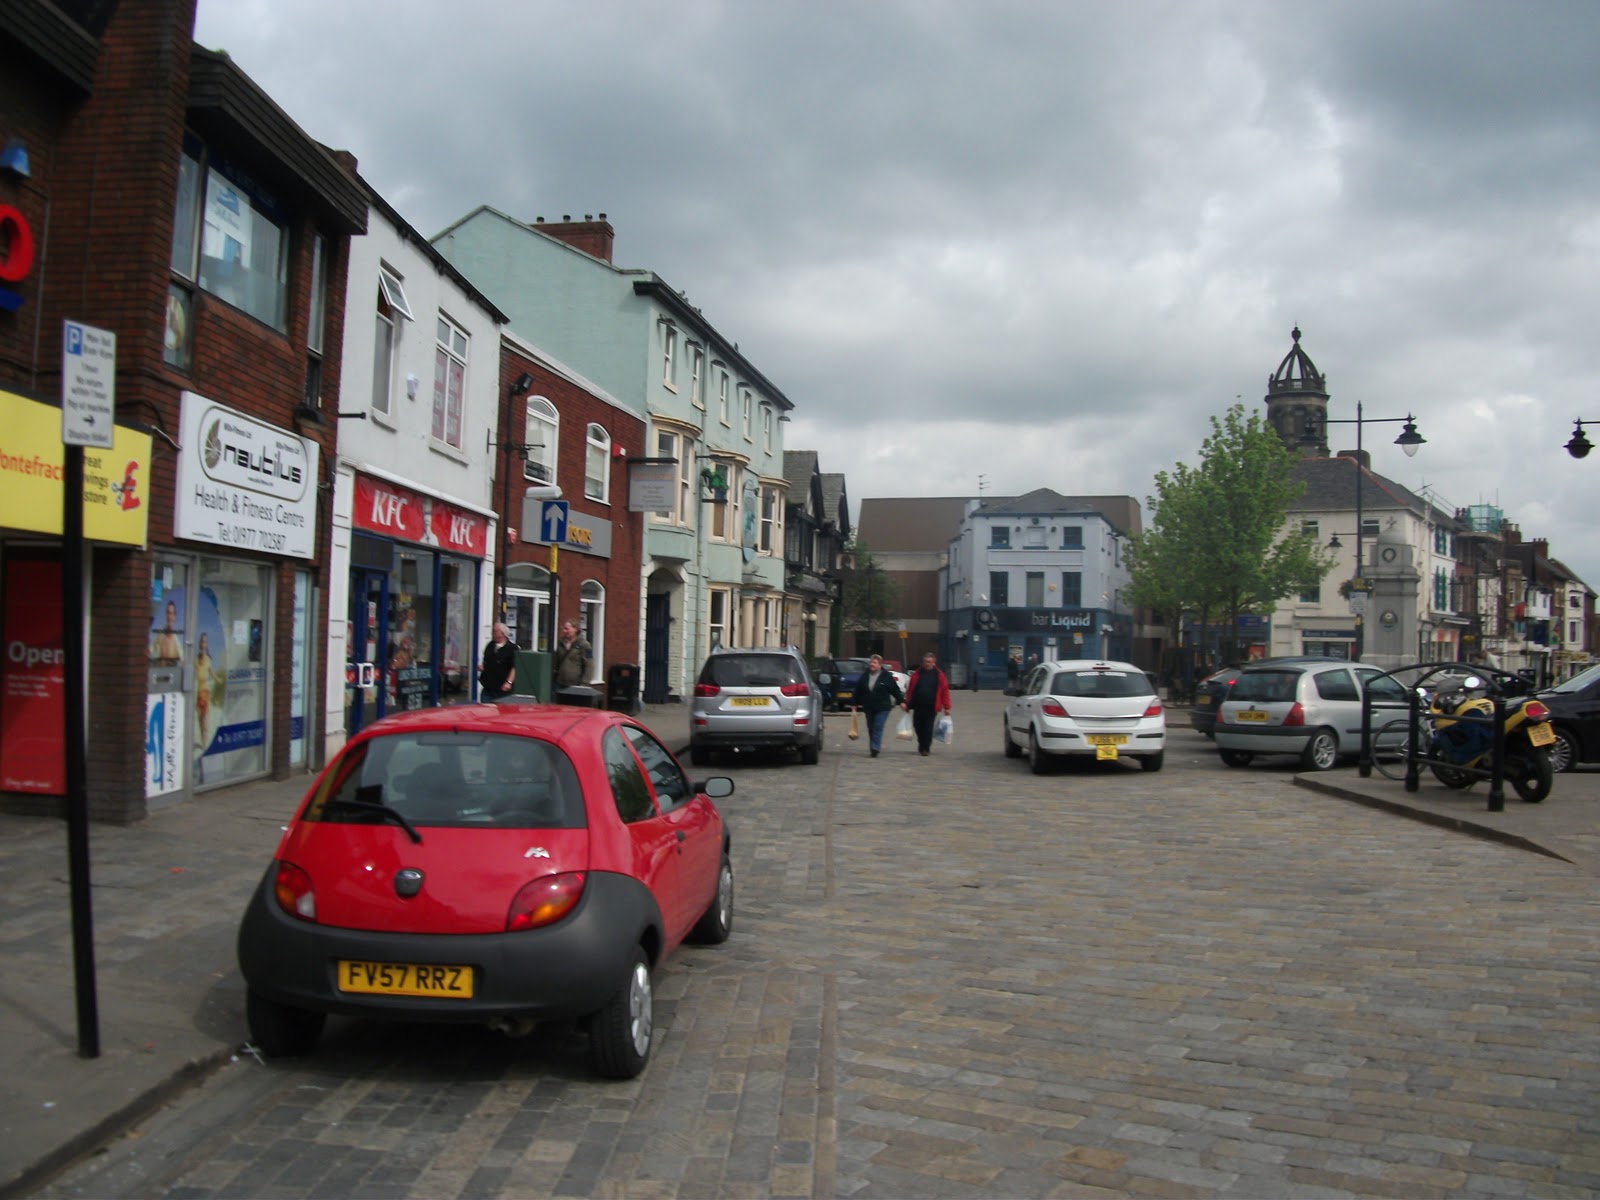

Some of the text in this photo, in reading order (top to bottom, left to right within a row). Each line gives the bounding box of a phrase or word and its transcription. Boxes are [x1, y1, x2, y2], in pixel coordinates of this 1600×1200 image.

[0, 447, 65, 481] ontefrac
[194, 483, 229, 513] Health
[242, 495, 274, 522] Fitness
[275, 503, 305, 528] Centre
[371, 489, 408, 530] KFC
[449, 514, 475, 548] KFC
[1031, 611, 1091, 630] bar Liquid
[348, 962, 462, 991] FV57 RRZ
